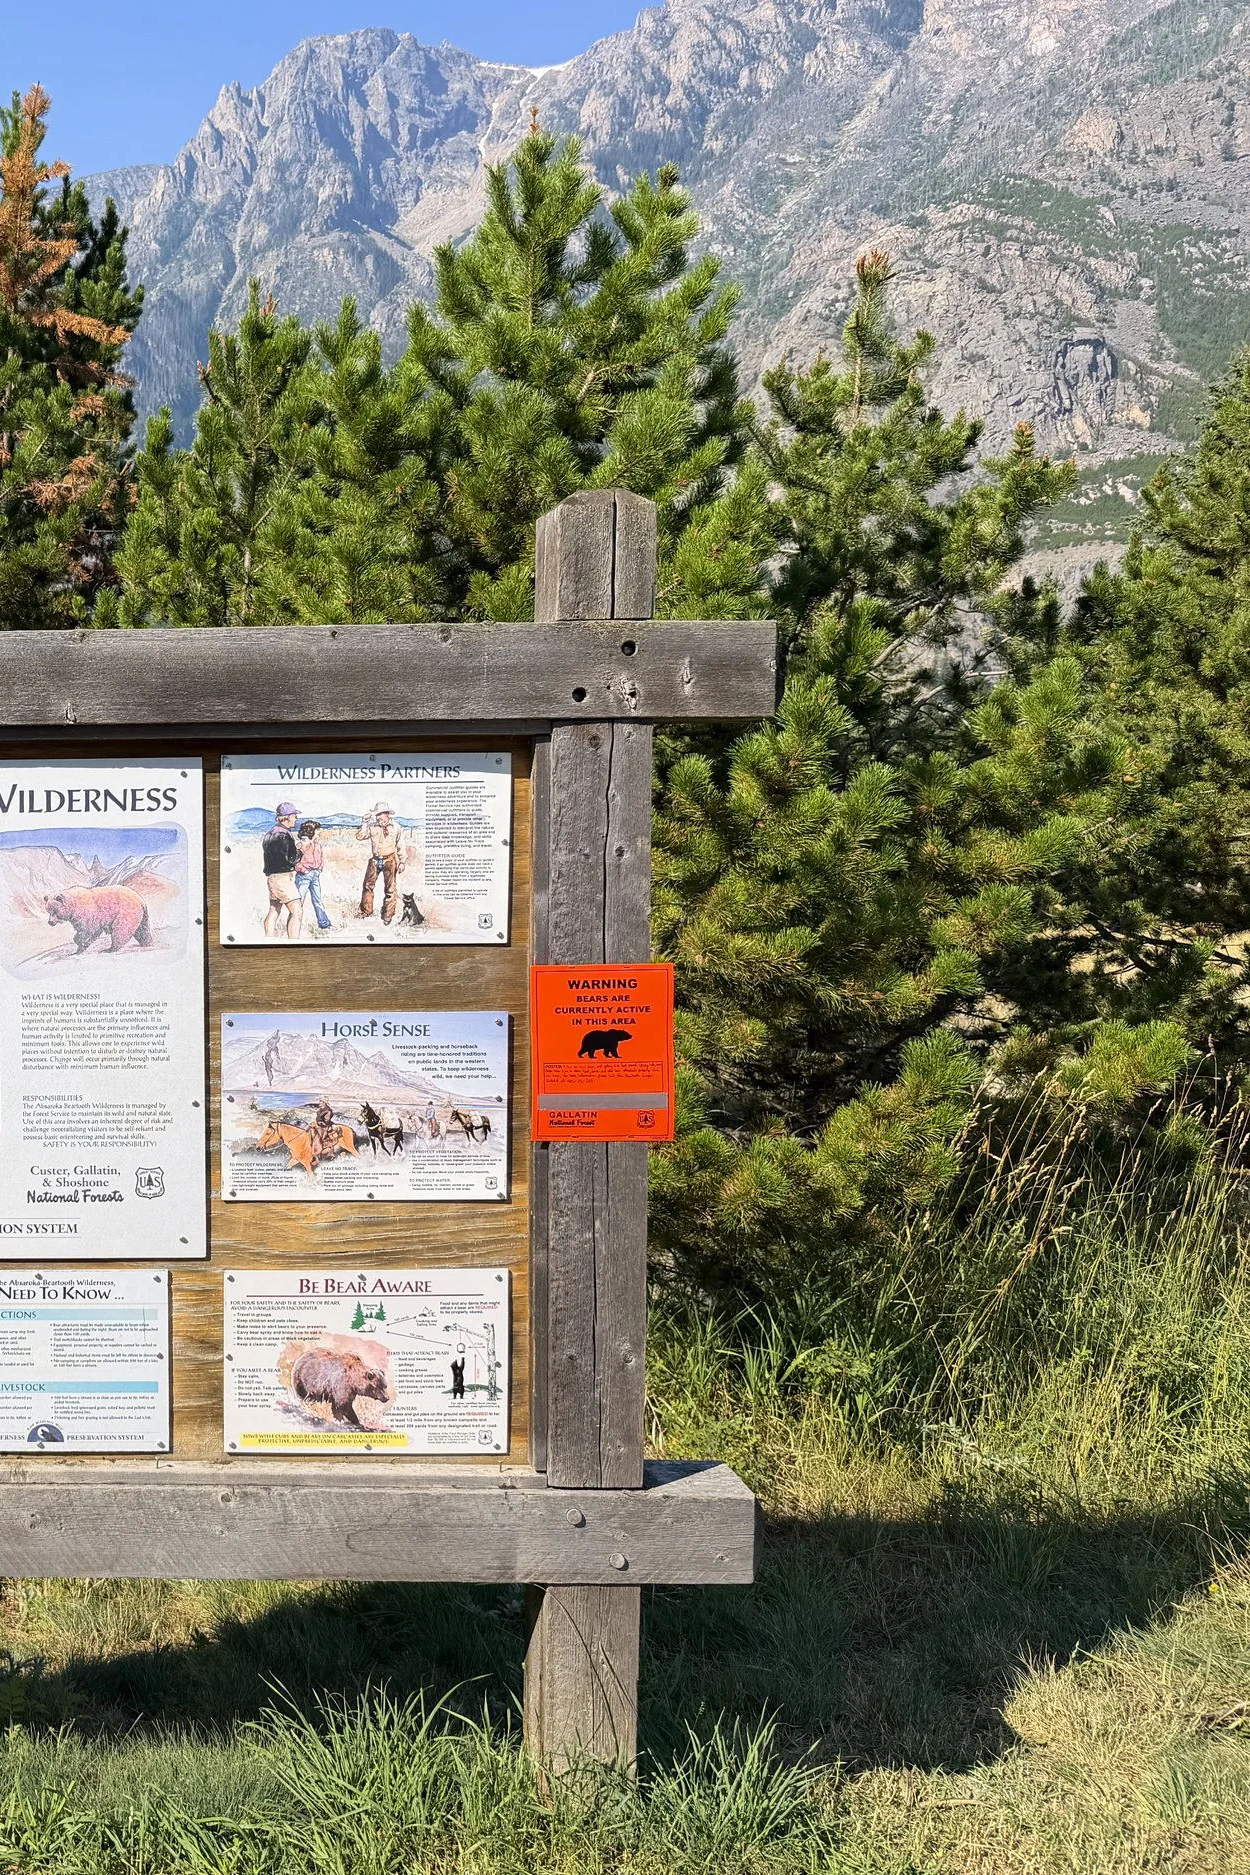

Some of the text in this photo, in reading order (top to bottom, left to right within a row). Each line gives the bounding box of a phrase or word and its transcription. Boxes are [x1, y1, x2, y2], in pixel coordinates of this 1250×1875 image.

[277, 762, 461, 779] WILDERNESS PARTNERS
[567, 978, 637, 989] WARNING
[610, 994, 630, 1002] ARE
[134, 1000, 160, 1008] managed
[119, 1008, 134, 1016] place
[554, 1005, 650, 1014] CURRENTLY ACTIVE
[610, 1017, 636, 1025] AREA
[321, 1021, 430, 1037] HORSE SENSE
[29, 1165, 120, 1177] Custer, Gallatin,
[42, 1177, 109, 1187] & Shoshone
[27, 1189, 124, 1203] National Forests
[26, 1223, 78, 1233] SYSTEM
[8, 1278, 75, 1286] Absaroka-Beartooth
[299, 1277, 432, 1293] BE BEAR AWARE
[39, 1286, 58, 1300] TO
[62, 1285, 111, 1299] KNOW
